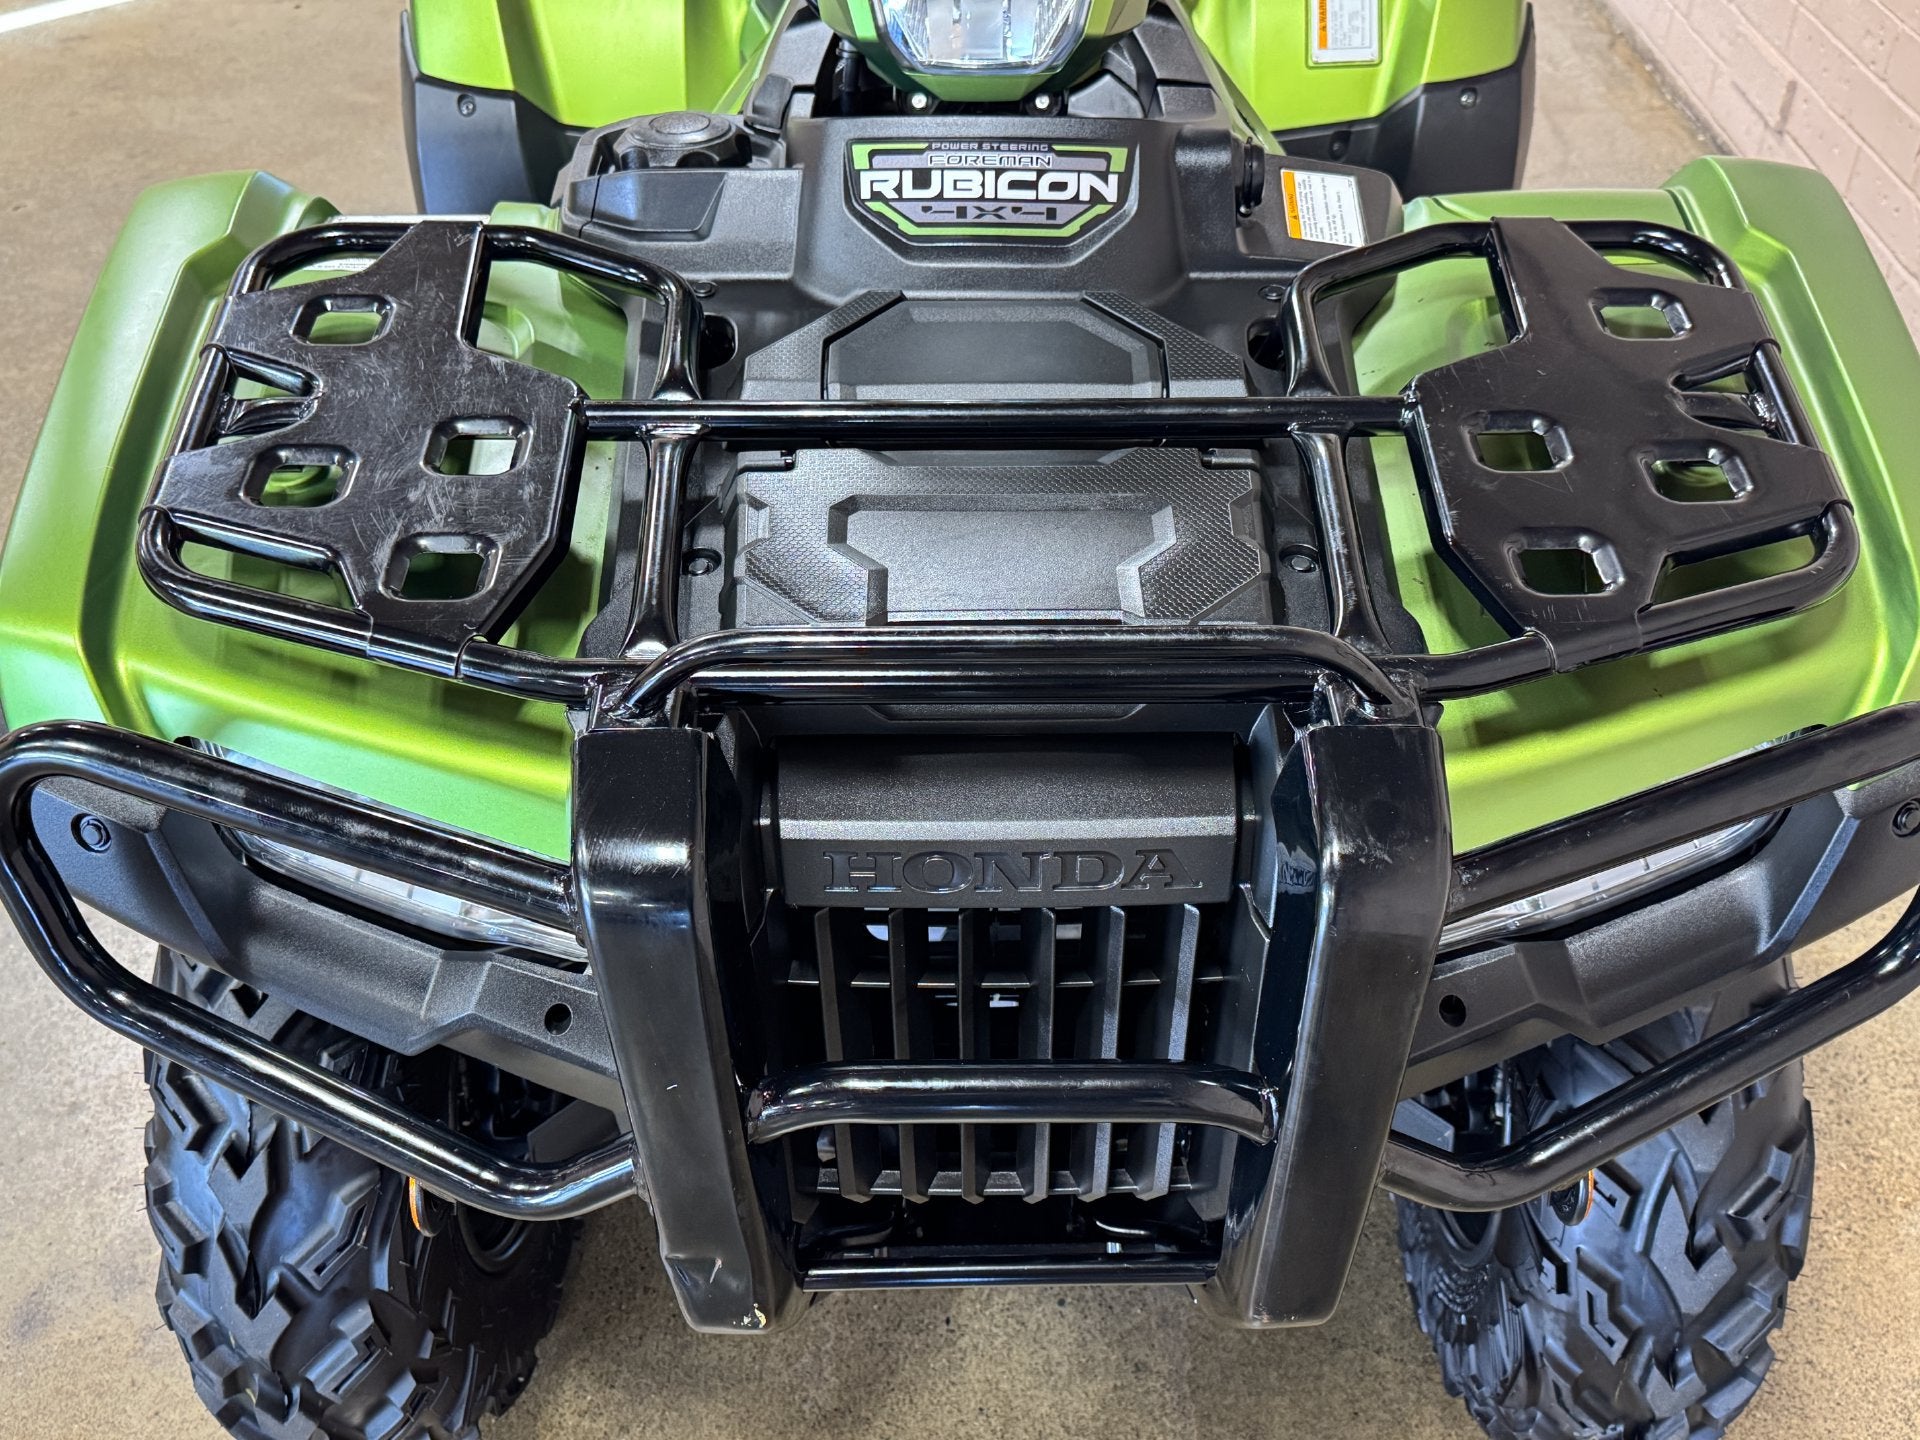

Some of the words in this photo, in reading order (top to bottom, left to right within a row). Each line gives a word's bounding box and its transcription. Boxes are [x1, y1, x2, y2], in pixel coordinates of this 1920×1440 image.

[931, 142, 978, 150] POWER
[982, 143, 1048, 151] STEERING
[928, 154, 1052, 168] FOREMAN
[860, 170, 1118, 202] RUBICON
[823, 849, 1203, 893] HONDA
